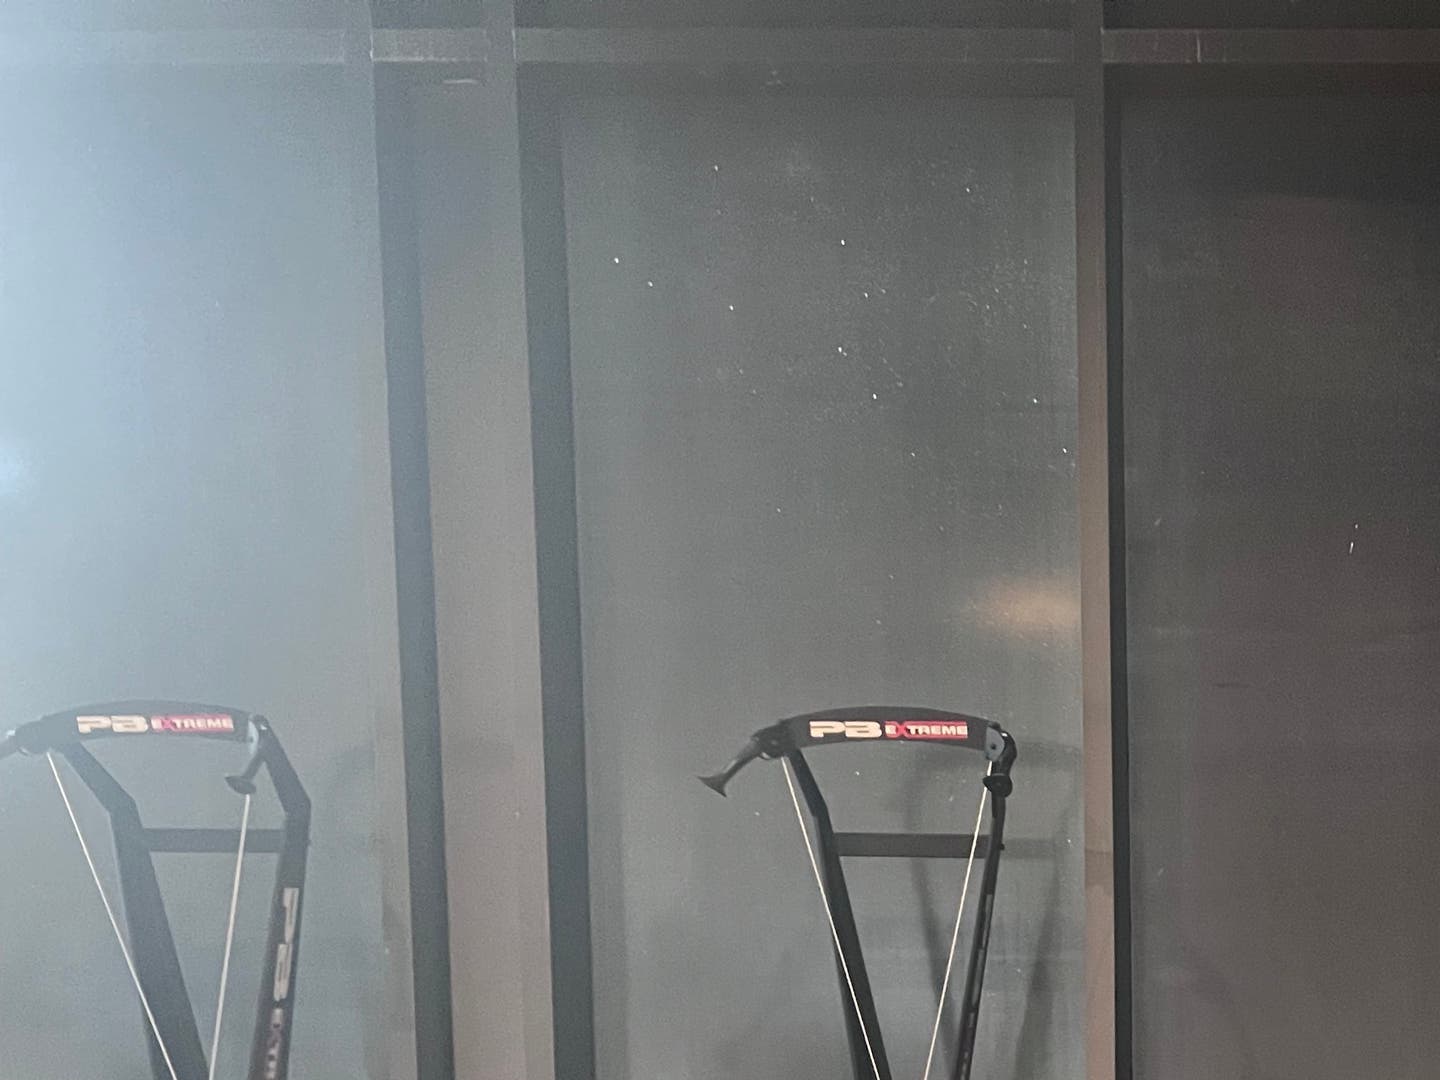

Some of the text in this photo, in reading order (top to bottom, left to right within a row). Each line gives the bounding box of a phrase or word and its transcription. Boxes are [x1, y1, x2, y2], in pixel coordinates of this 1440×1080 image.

[76, 715, 234, 733] PB EXTREME
[809, 720, 968, 738] PB EXTREME
